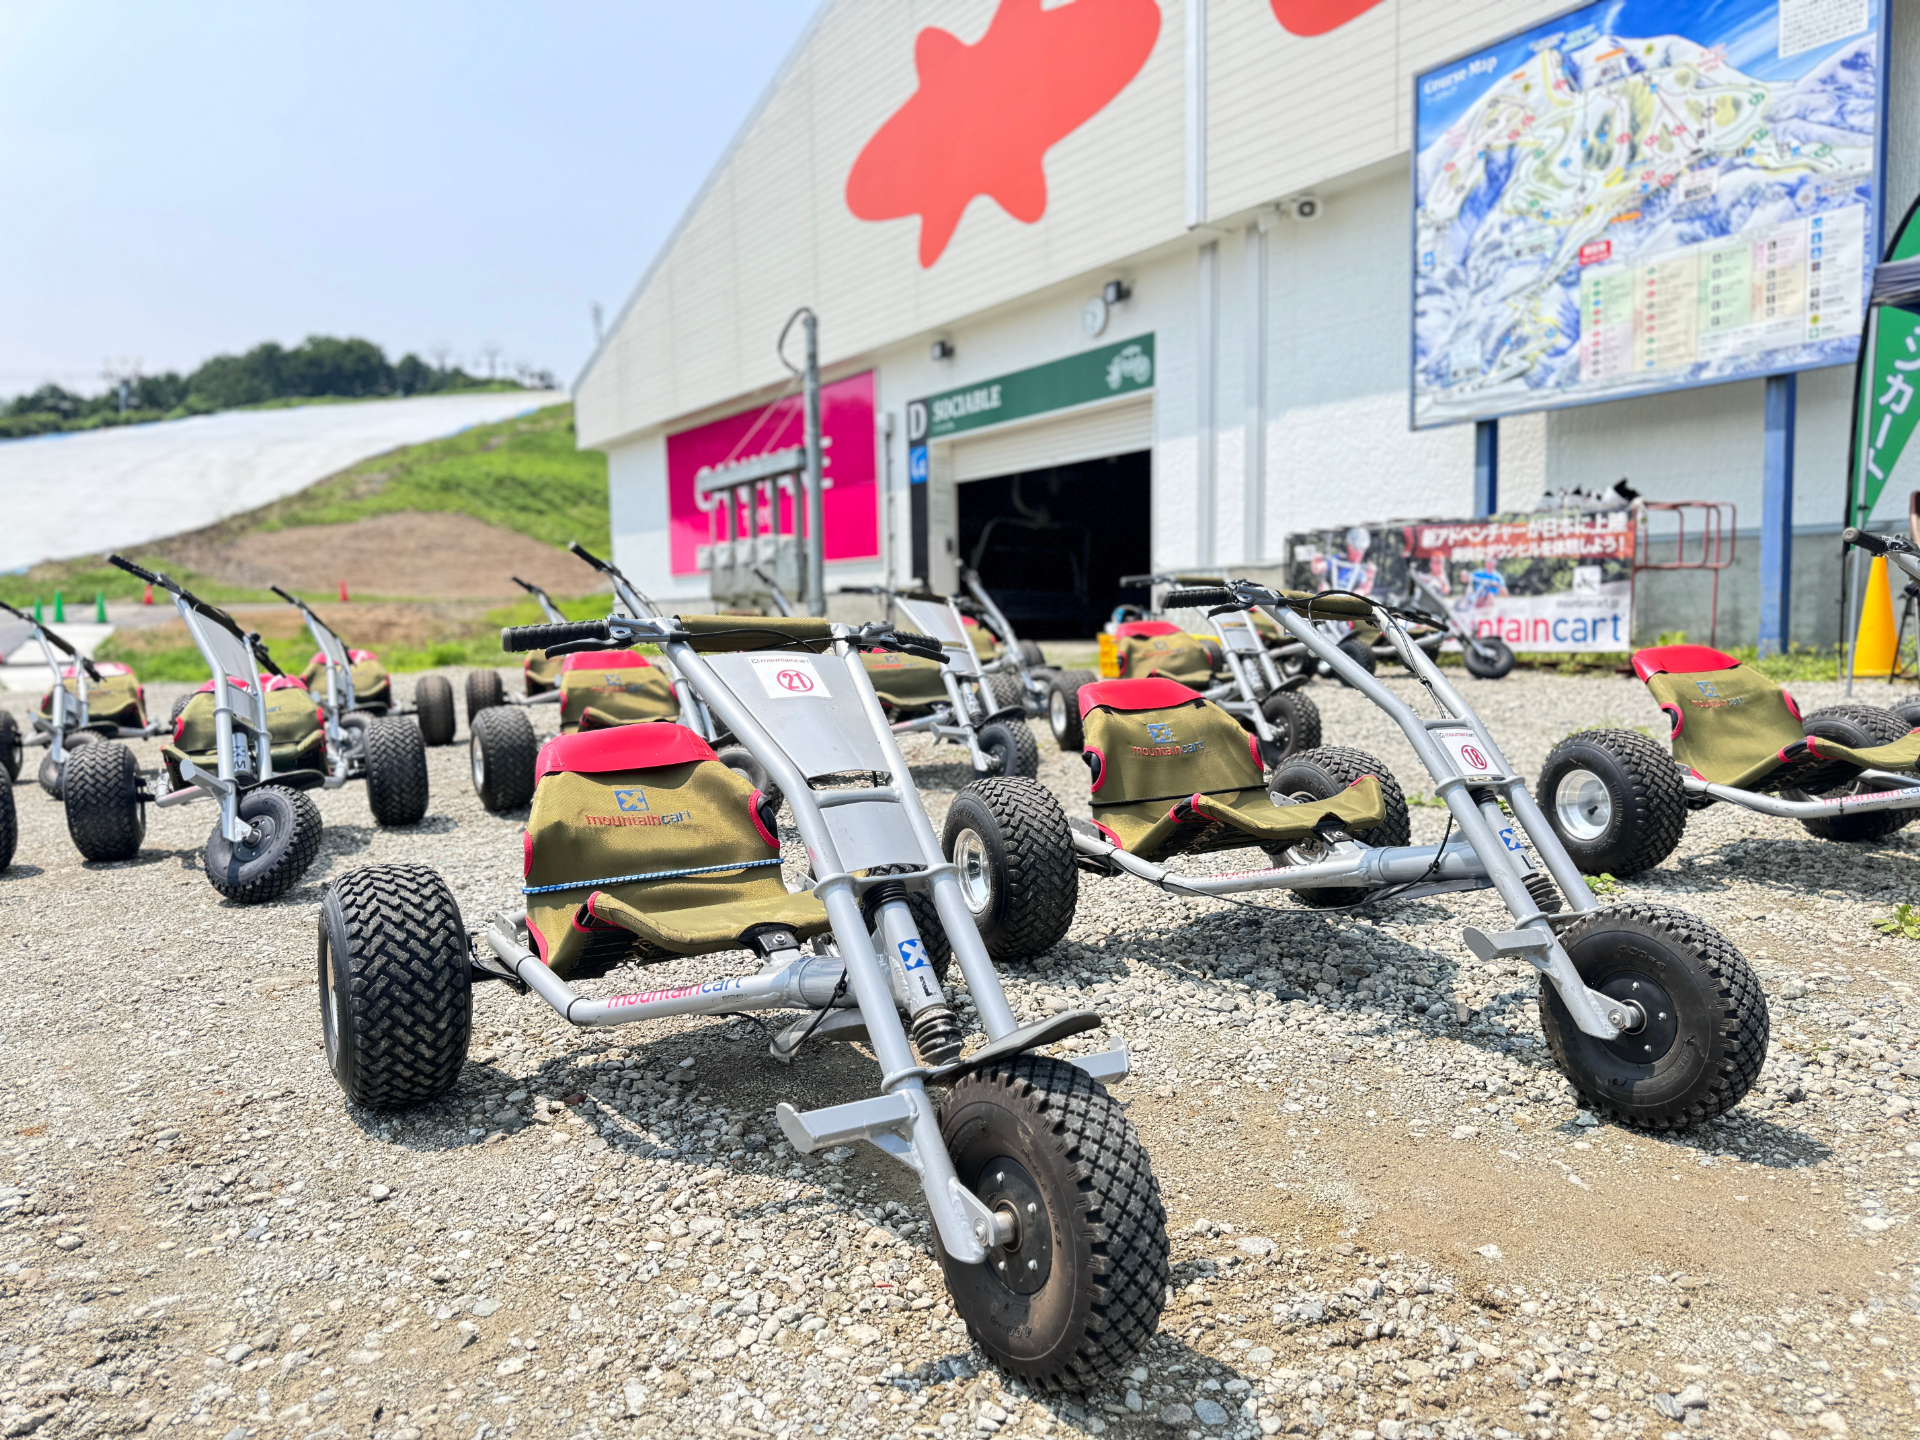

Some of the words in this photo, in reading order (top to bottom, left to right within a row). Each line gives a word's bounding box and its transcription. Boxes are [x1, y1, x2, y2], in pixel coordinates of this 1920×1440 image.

[1424, 69, 1467, 95] Course
[1468, 56, 1498, 78] Map
[909, 402, 928, 441] D
[781, 672, 808, 691] 21
[1131, 740, 1204, 757] mountaincart
[1463, 748, 1485, 767] 18
[585, 810, 693, 827] mountaincart
[607, 978, 741, 1009] mountaincart
